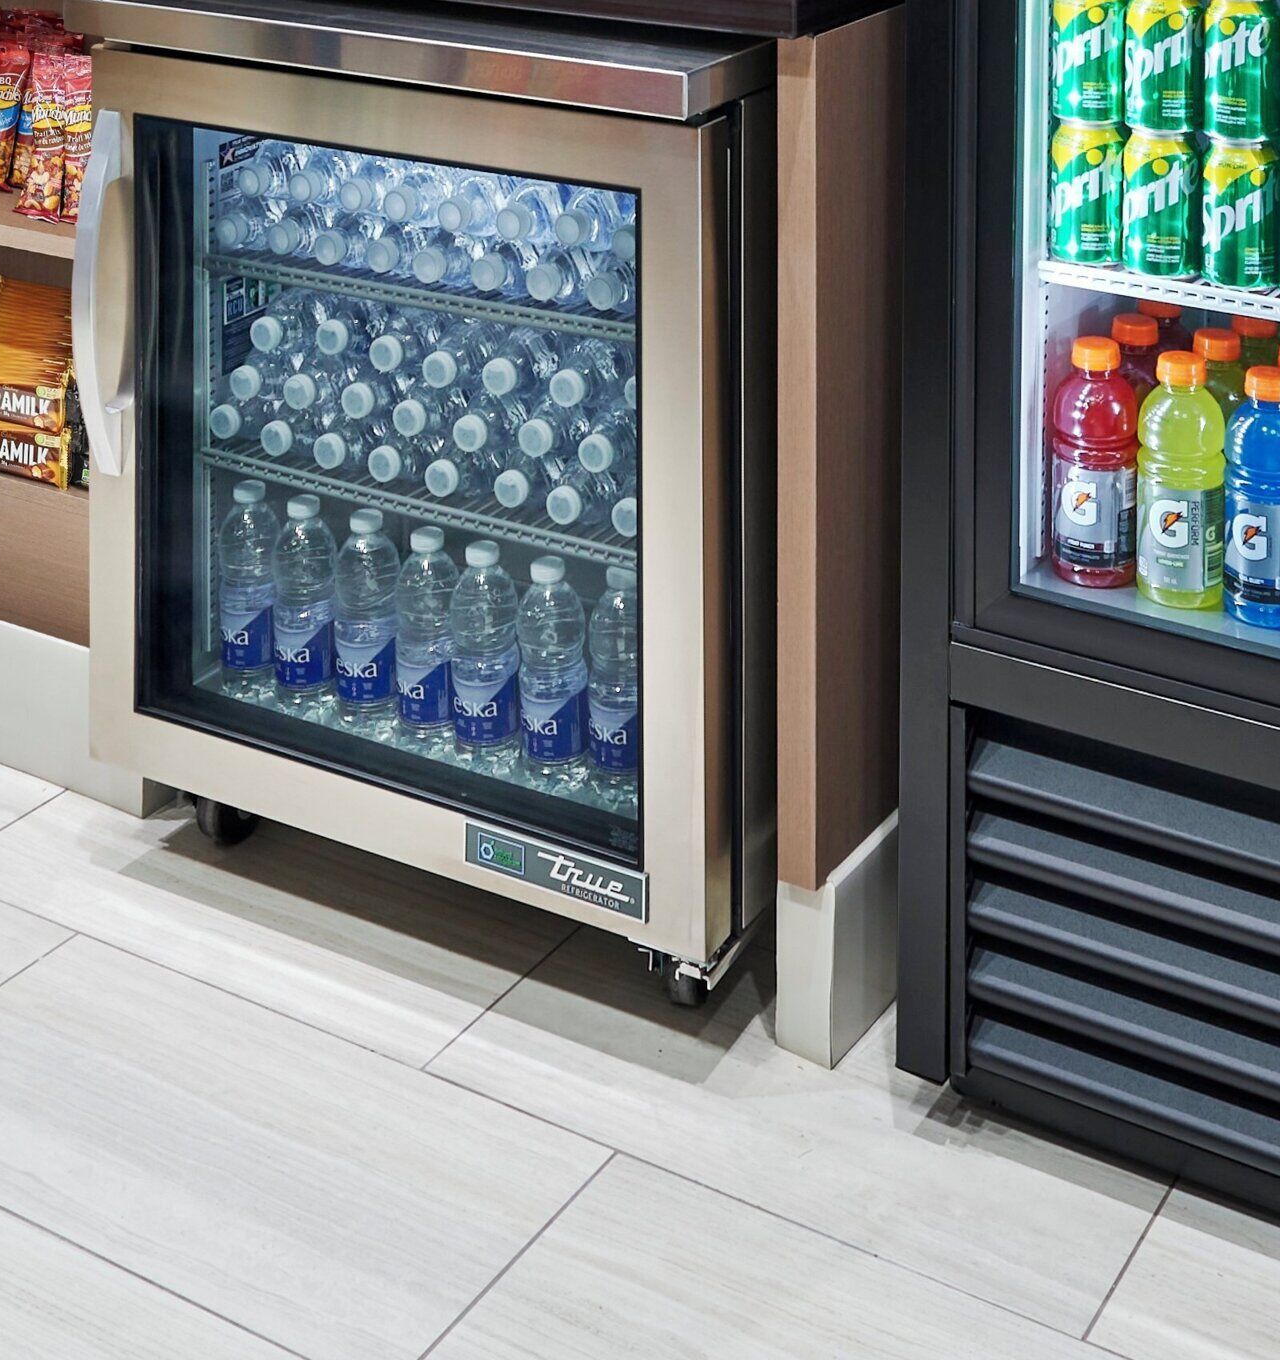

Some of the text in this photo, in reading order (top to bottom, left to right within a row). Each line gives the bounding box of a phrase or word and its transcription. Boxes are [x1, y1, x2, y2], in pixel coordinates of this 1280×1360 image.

[1061, 481, 1097, 526] G
[1149, 500, 1188, 548] G
[1191, 501, 1200, 546] PERFORM
[1233, 513, 1268, 560] G
[454, 696, 497, 718] eska
[537, 851, 630, 903] true
[561, 883, 621, 910] REFRIGERATOR
